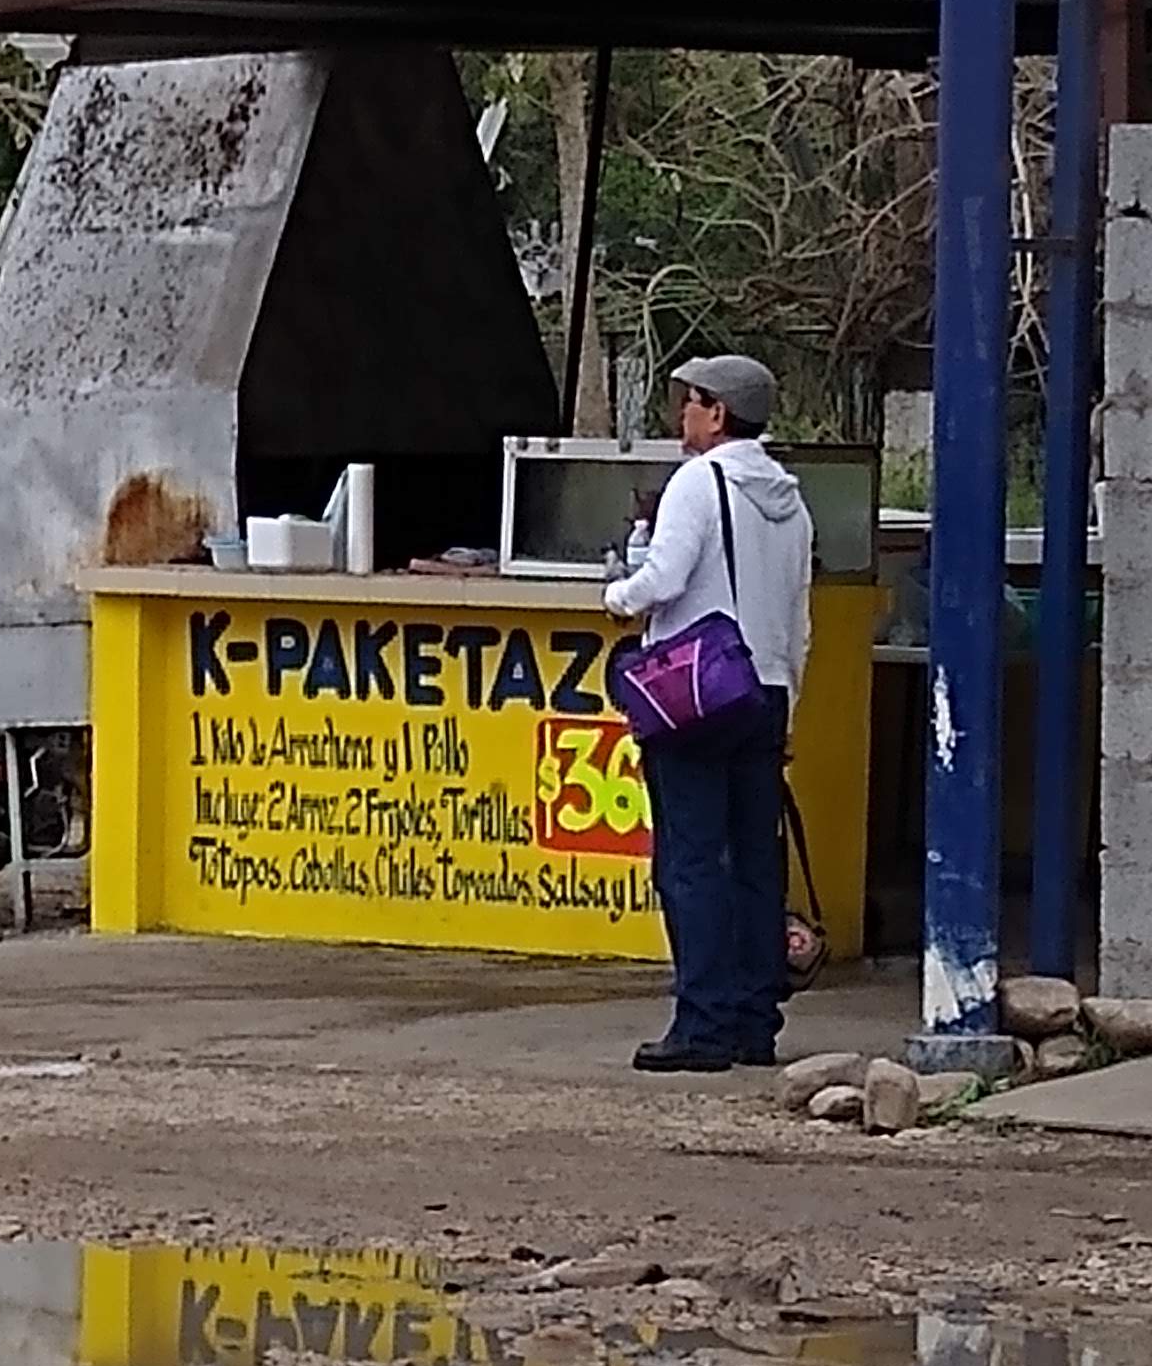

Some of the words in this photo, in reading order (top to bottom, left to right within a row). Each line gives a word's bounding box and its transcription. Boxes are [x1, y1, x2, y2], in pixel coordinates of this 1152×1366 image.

[192, 711, 206, 766] 1
[384, 739, 398, 782] y
[402, 721, 413, 772] 1
[423, 716, 469, 777] Pollo
[538, 721, 653, 839] $36
[268, 780, 285, 831] 2
[346, 788, 362, 835] 2
[538, 853, 609, 908] Salsa
[611, 880, 626, 924] y
